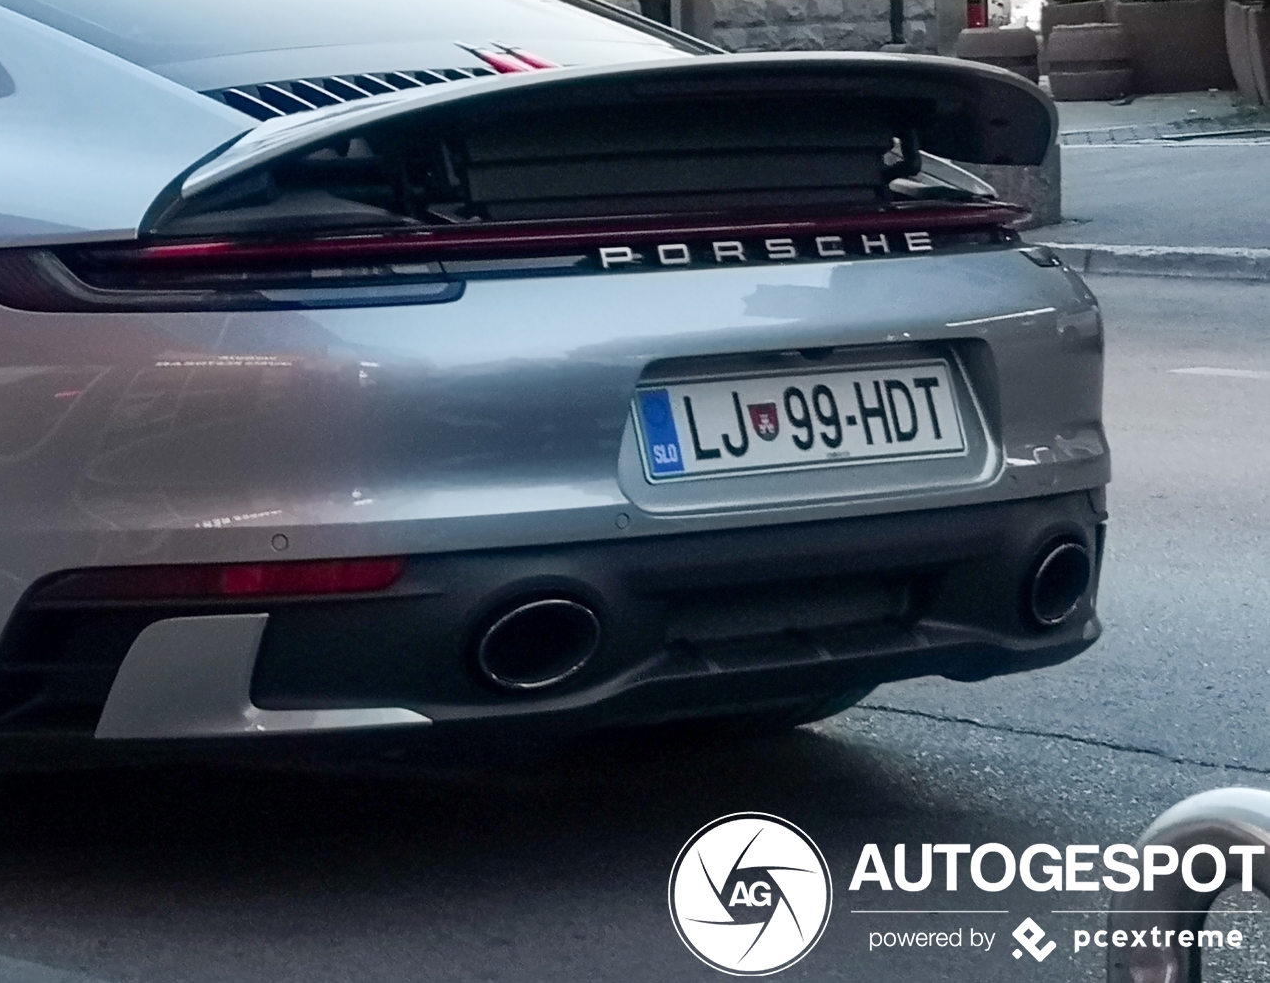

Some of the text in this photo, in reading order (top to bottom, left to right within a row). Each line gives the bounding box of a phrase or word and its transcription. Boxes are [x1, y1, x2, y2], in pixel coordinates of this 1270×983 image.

[599, 231, 934, 269] PORSCHE
[683, 376, 943, 460] LJ 99-HDT
[653, 444, 679, 464] SLO
